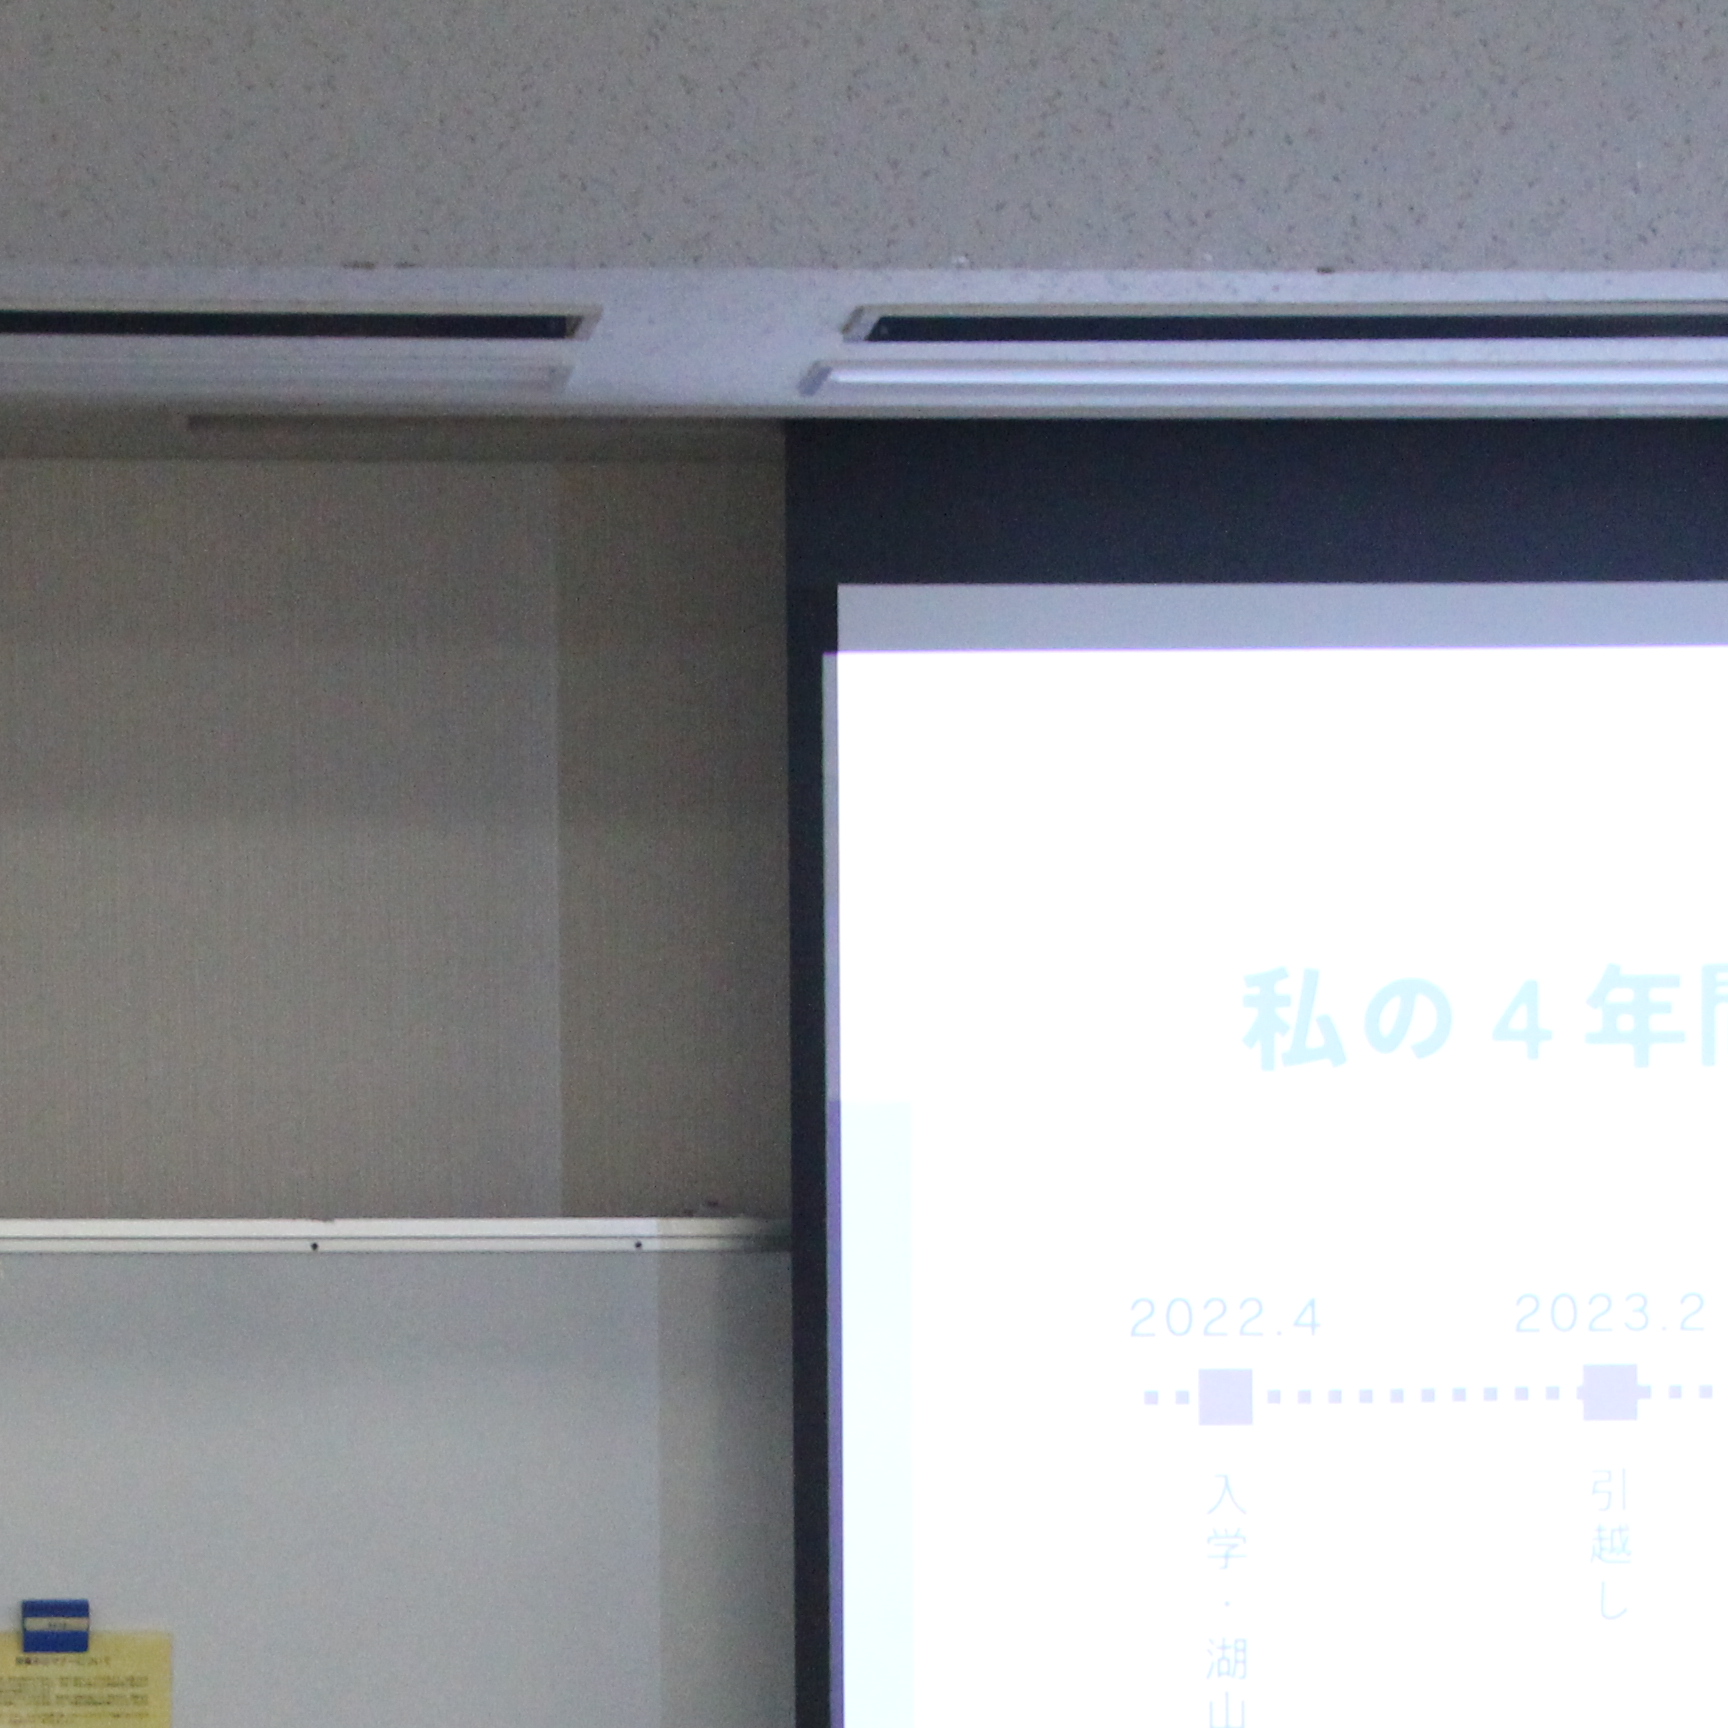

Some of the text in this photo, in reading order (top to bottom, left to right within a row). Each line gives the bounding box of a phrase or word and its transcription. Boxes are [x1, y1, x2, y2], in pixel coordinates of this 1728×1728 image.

[1129, 1296, 1322, 1338] 2022.4
[1514, 1291, 1707, 1334] 2023.2
[1589, 1467, 1633, 1621] 引越し
